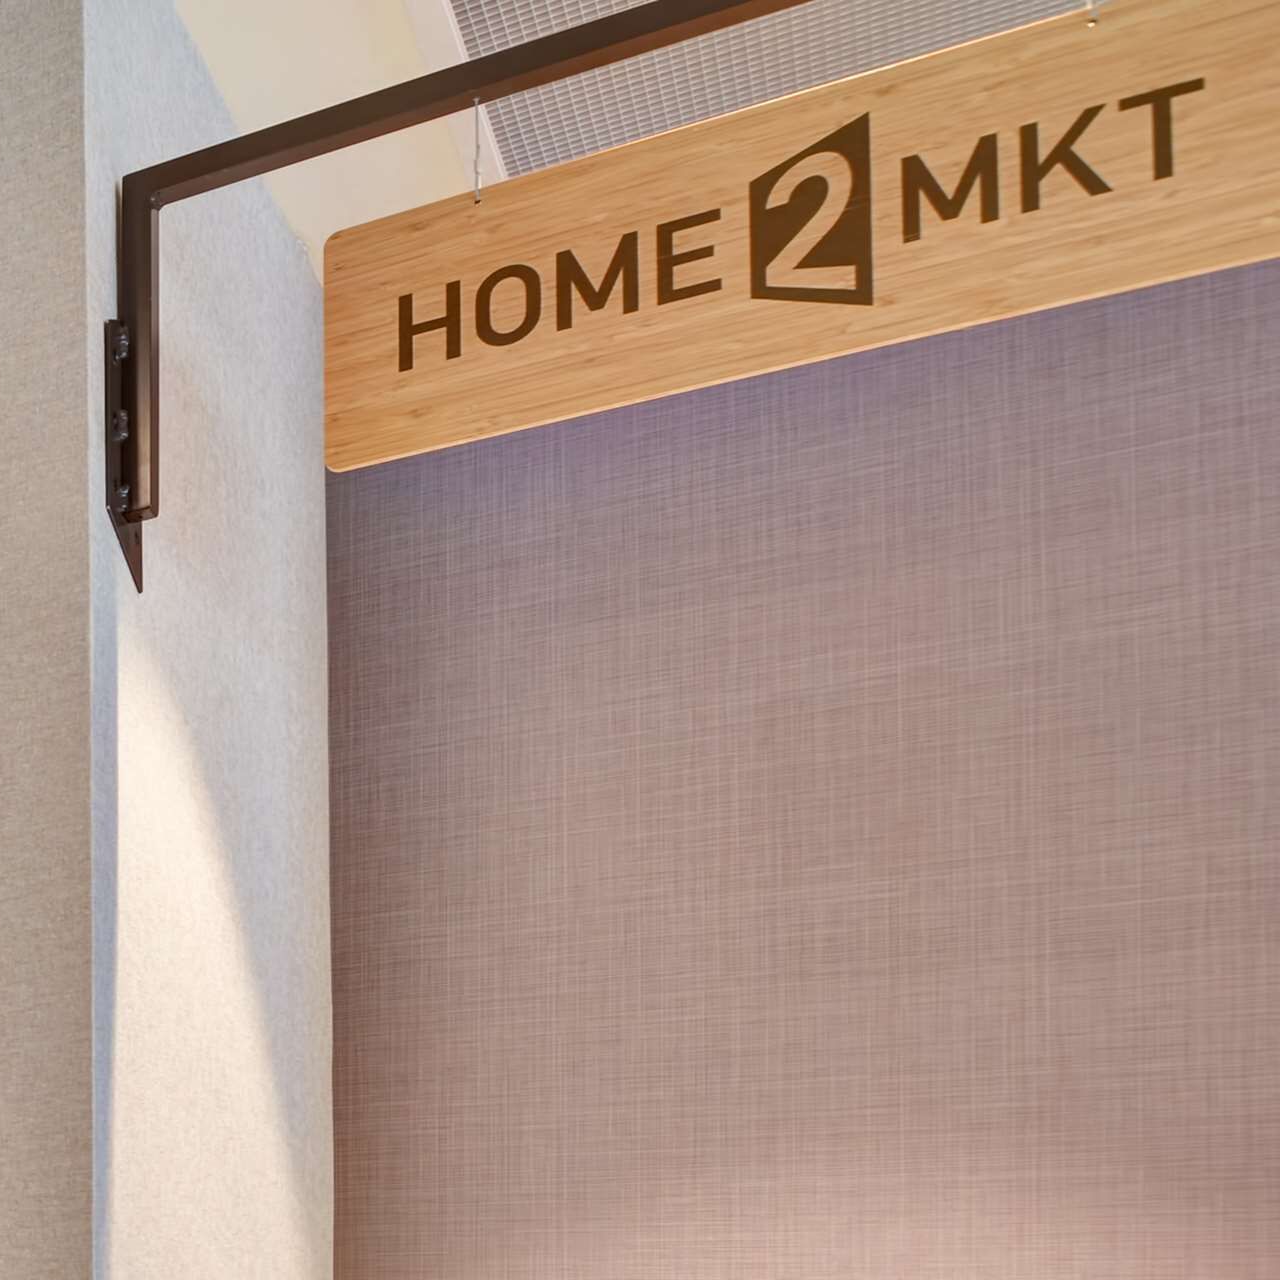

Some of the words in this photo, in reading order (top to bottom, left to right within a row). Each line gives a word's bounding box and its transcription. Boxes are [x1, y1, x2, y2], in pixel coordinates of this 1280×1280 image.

[397, 207, 724, 373] HOME
[761, 145, 861, 293] 2
[900, 77, 1206, 243] MKT
